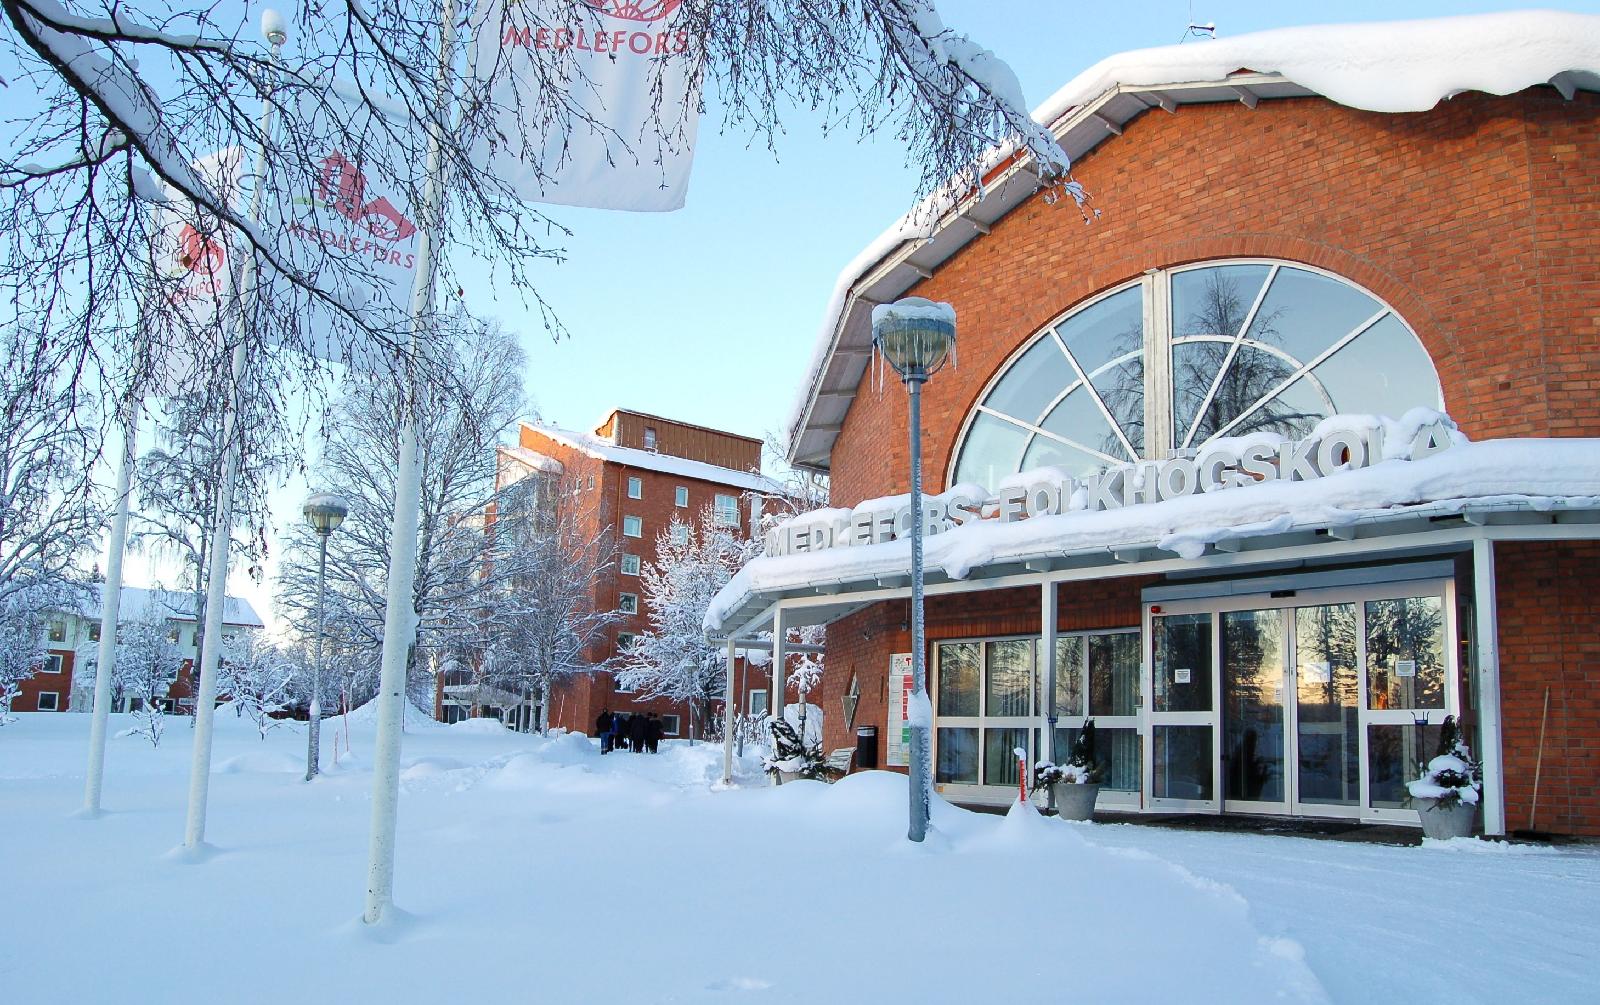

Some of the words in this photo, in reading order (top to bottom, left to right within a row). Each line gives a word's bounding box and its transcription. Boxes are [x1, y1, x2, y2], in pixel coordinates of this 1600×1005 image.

[502, 26, 688, 55] MEDLEFORS
[288, 220, 415, 269] MEDLEFORS
[765, 496, 972, 557] MEDLEFORS
[1000, 419, 1453, 523] FOLKHÖGSKOLA
